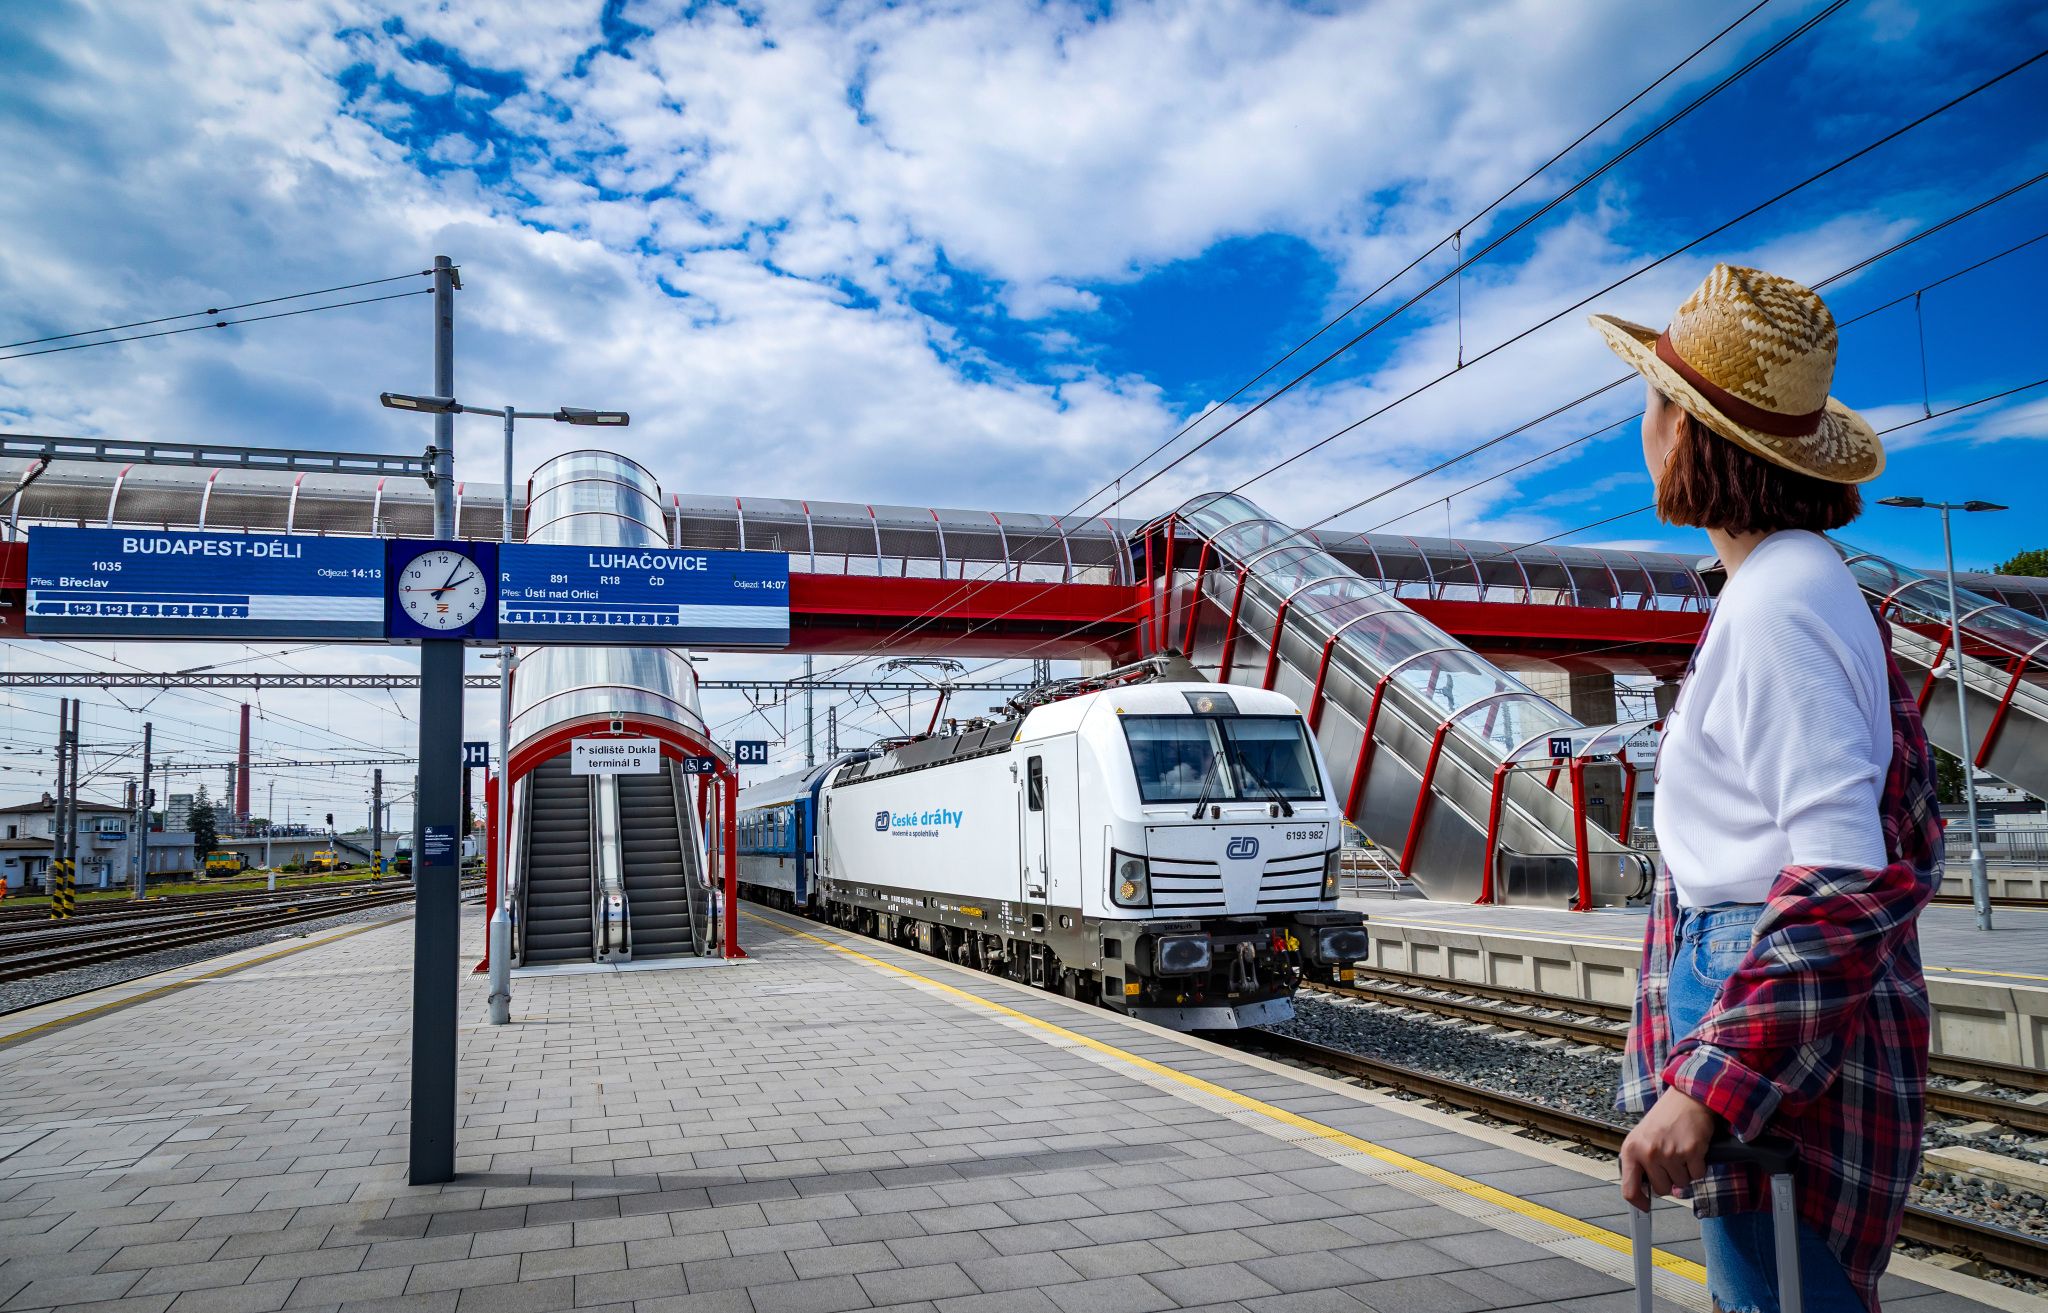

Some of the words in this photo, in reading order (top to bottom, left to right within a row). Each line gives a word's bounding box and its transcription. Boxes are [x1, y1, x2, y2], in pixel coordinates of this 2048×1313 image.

[122, 537, 302, 559] BUDAPEST-DÉLI
[438, 556, 448, 564] 12
[588, 552, 708, 571] LUHAČOVICE
[91, 561, 122, 572] 1035
[317, 568, 349, 579] Odjezd:
[351, 568, 382, 579] 14:13
[410, 571, 421, 579] 10
[468, 571, 475, 579] 2
[30, 577, 55, 586] Přes:
[59, 576, 109, 588] Břeclav
[502, 573, 510, 582] R
[550, 574, 568, 584] 891
[600, 575, 621, 585] R18
[649, 575, 665, 586] ČD
[405, 585, 411, 593] 9
[733, 580, 760, 590] Odjezd:
[761, 580, 787, 590] 14:07
[524, 586, 546, 598] Ústí
[548, 589, 569, 599] nad
[74, 604, 92, 613] 1+2
[105, 605, 123, 614] 1+2
[141, 606, 148, 614] 2
[172, 606, 179, 615] 2
[202, 607, 209, 615] 2
[231, 608, 239, 616] 2
[410, 601, 417, 609] 8
[468, 602, 476, 610] 4
[422, 612, 429, 620] 7
[439, 616, 446, 625] 6
[456, 612, 463, 621] 5
[541, 613, 547, 621] 1
[567, 614, 573, 622] 2
[616, 615, 623, 623] 2
[588, 744, 625, 755] sídliště
[627, 745, 656, 755] Dukla
[1552, 741, 1571, 754] 7H
[739, 745, 765, 761] 8H
[588, 757, 630, 768] terminál
[633, 759, 641, 768] B
[891, 812, 918, 827] České
[920, 808, 963, 829] dráhy
[1286, 831, 1307, 840] 6193
[1308, 830, 1324, 840] 982
[1054, 879, 1058, 888] 2
